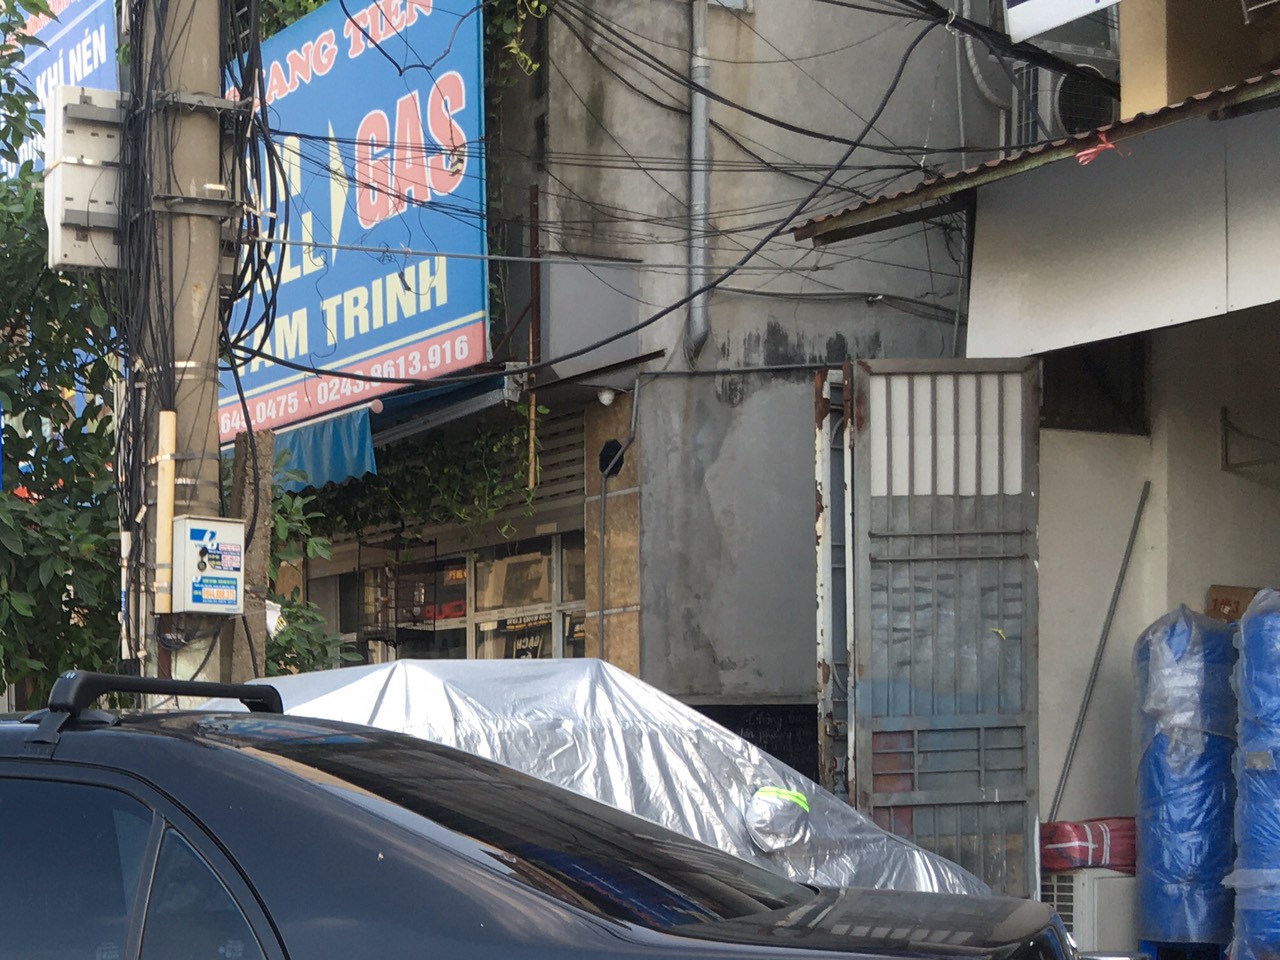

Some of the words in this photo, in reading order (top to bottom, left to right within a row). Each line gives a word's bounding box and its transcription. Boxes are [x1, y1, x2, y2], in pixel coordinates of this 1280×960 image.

[69, 23, 107, 87] NÉN
[355, 70, 467, 229] GAS
[322, 255, 448, 347] TRINH
